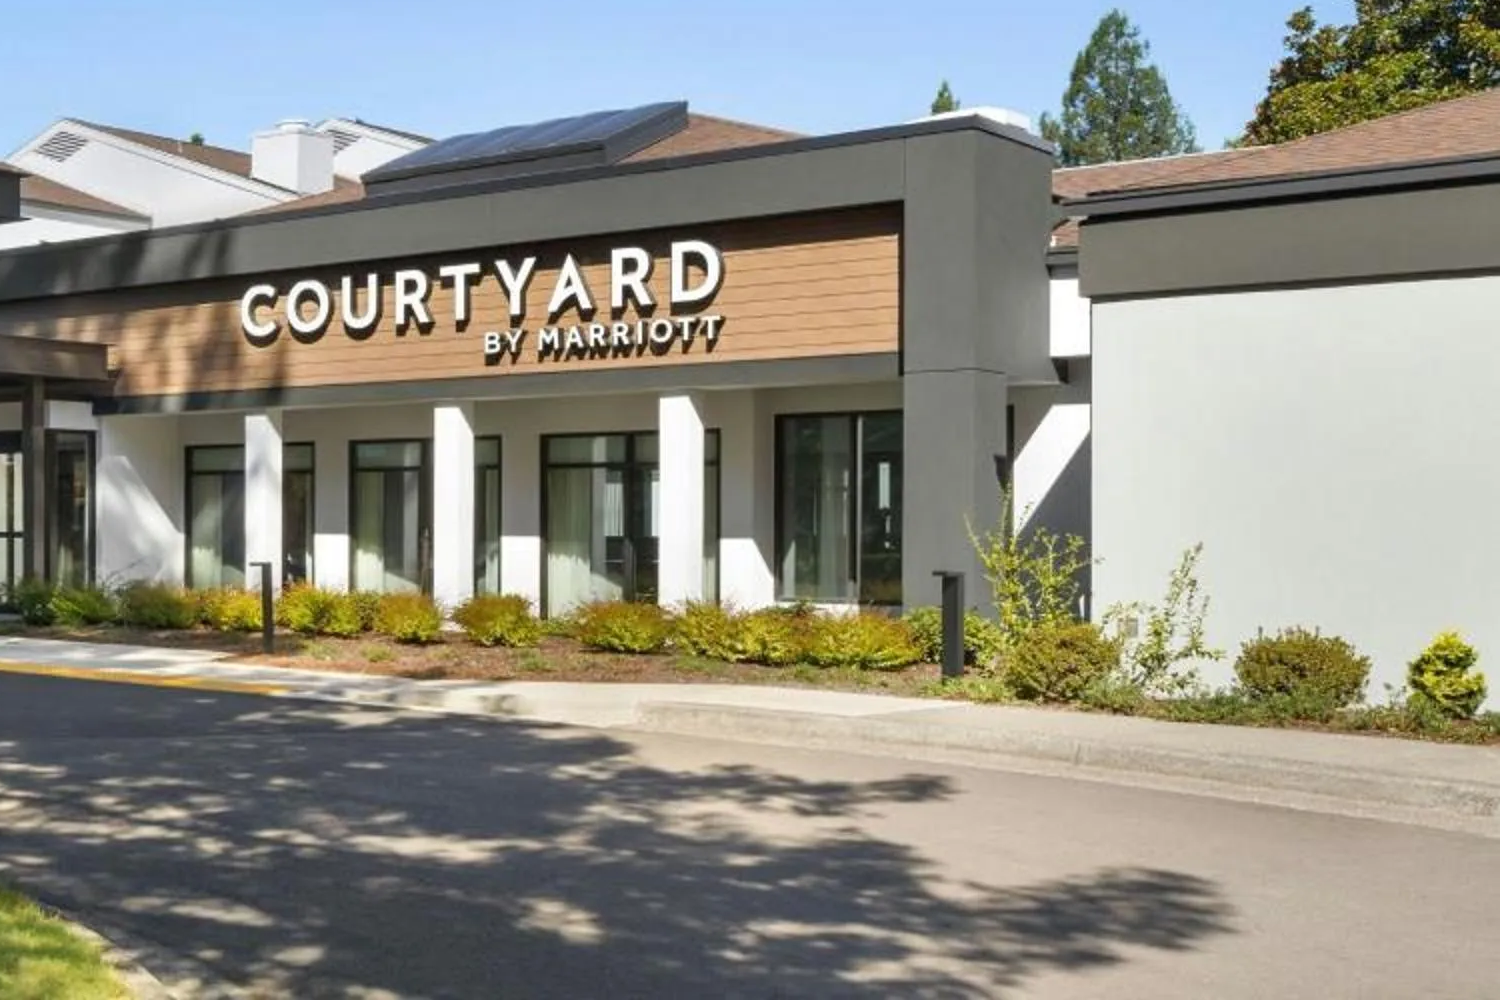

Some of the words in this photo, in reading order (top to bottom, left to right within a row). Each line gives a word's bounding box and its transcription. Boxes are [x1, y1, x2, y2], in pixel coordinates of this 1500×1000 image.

[240, 239, 722, 340] COURTYARD
[484, 330, 525, 355] BY
[537, 314, 723, 354] MARRIOTT
